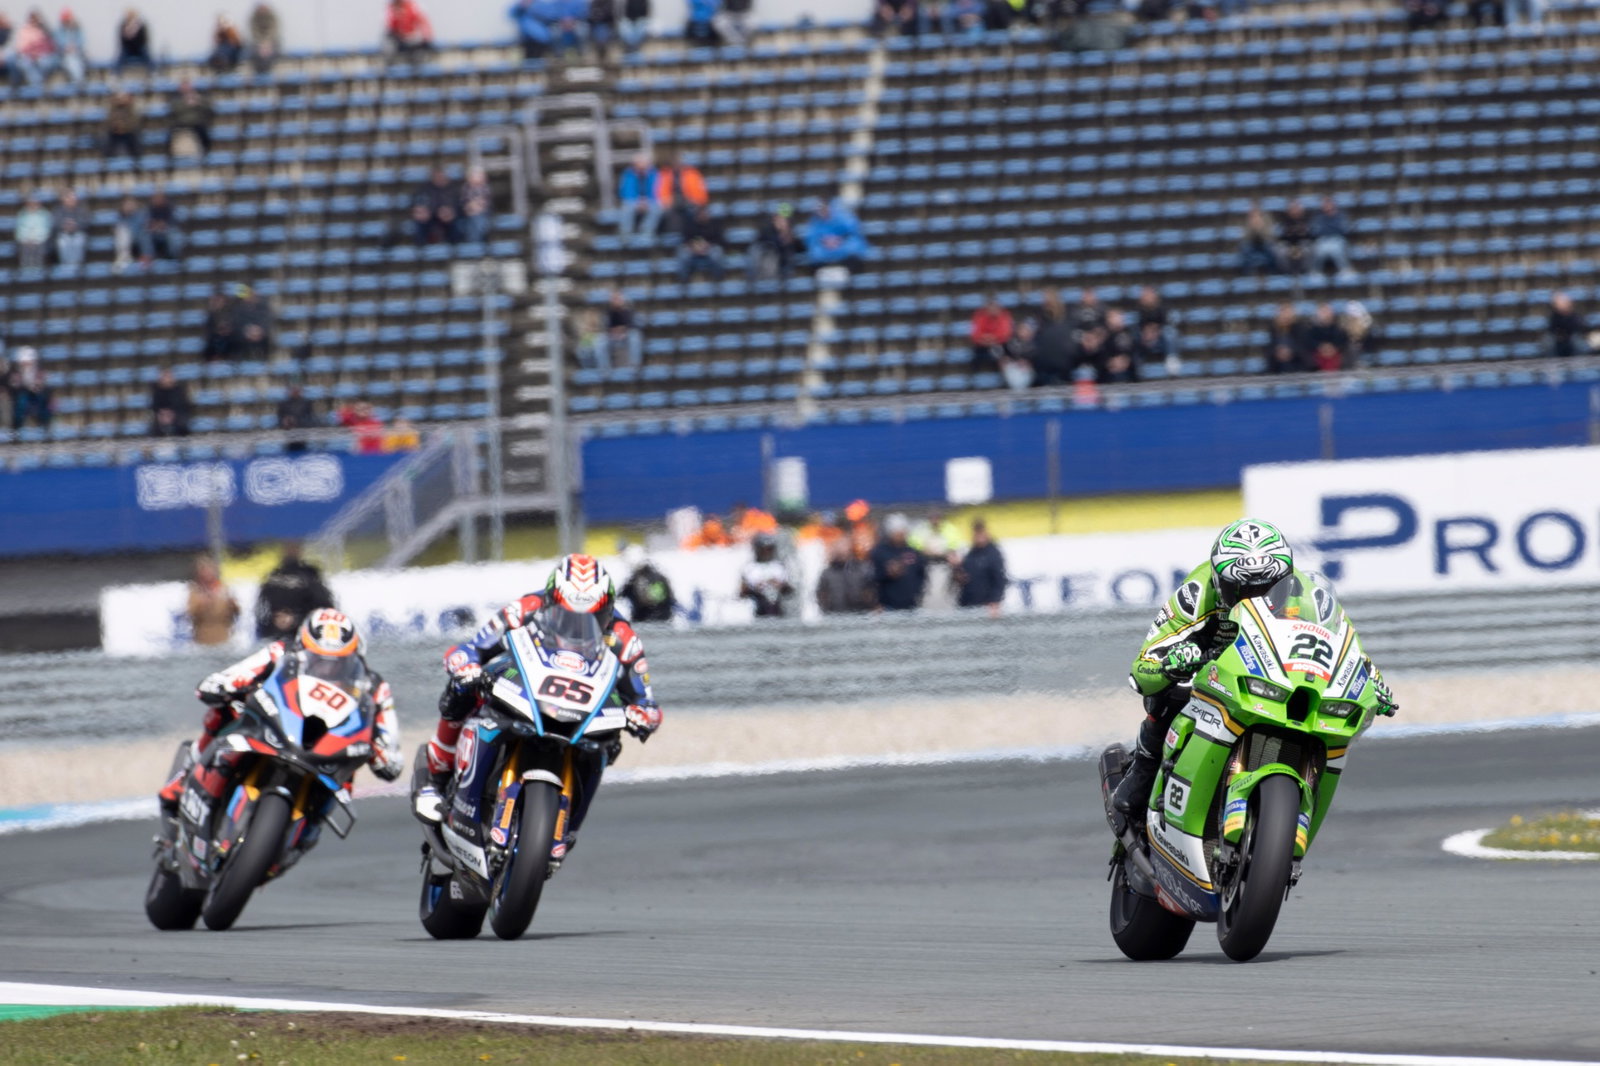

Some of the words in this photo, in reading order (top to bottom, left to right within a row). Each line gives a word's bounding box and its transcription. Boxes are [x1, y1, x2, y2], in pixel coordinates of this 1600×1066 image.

[1291, 623, 1331, 640] SHOWA
[1251, 634, 1278, 671] Kawasaki
[1288, 633, 1334, 670] 22
[1335, 658, 1355, 688] Kawasaki
[308, 682, 347, 711] 60
[538, 675, 594, 706] 65
[1169, 782, 1184, 811] 22
[1153, 825, 1190, 867] Kawasaki
